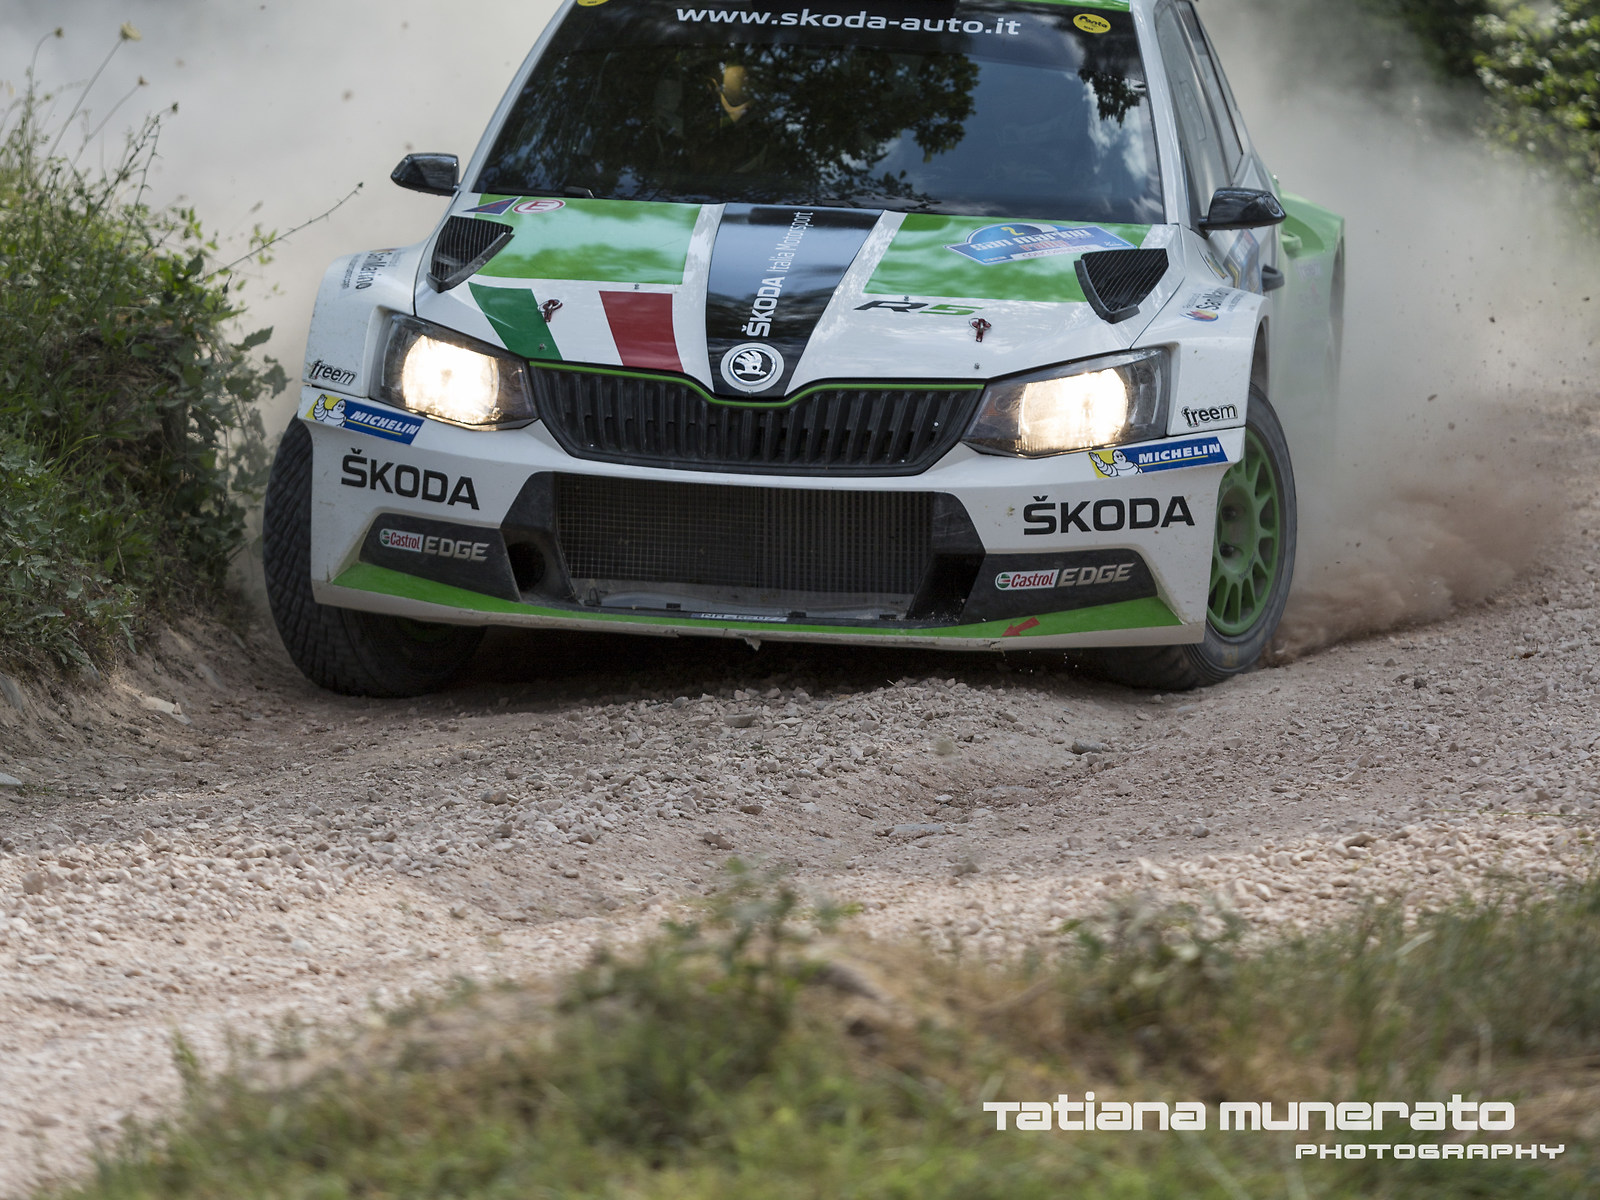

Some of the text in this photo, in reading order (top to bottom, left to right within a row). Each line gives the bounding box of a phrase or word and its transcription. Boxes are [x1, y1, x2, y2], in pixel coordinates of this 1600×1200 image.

[676, 8, 1021, 35] www.skoda-auto.it
[1001, 227, 1025, 237] 2
[741, 211, 814, 337] ŠKODA Italia Motorsport
[853, 300, 985, 316] R5
[311, 360, 356, 385] freem
[350, 410, 421, 436] MICHELIN
[1182, 404, 1238, 427] freem
[1138, 443, 1221, 463] MICHELIN
[341, 448, 480, 510] ŠKODA
[1023, 495, 1195, 535] ŠKODA
[390, 531, 490, 561] Castrol EDGE
[1010, 563, 1136, 588] Castrol EDGE
